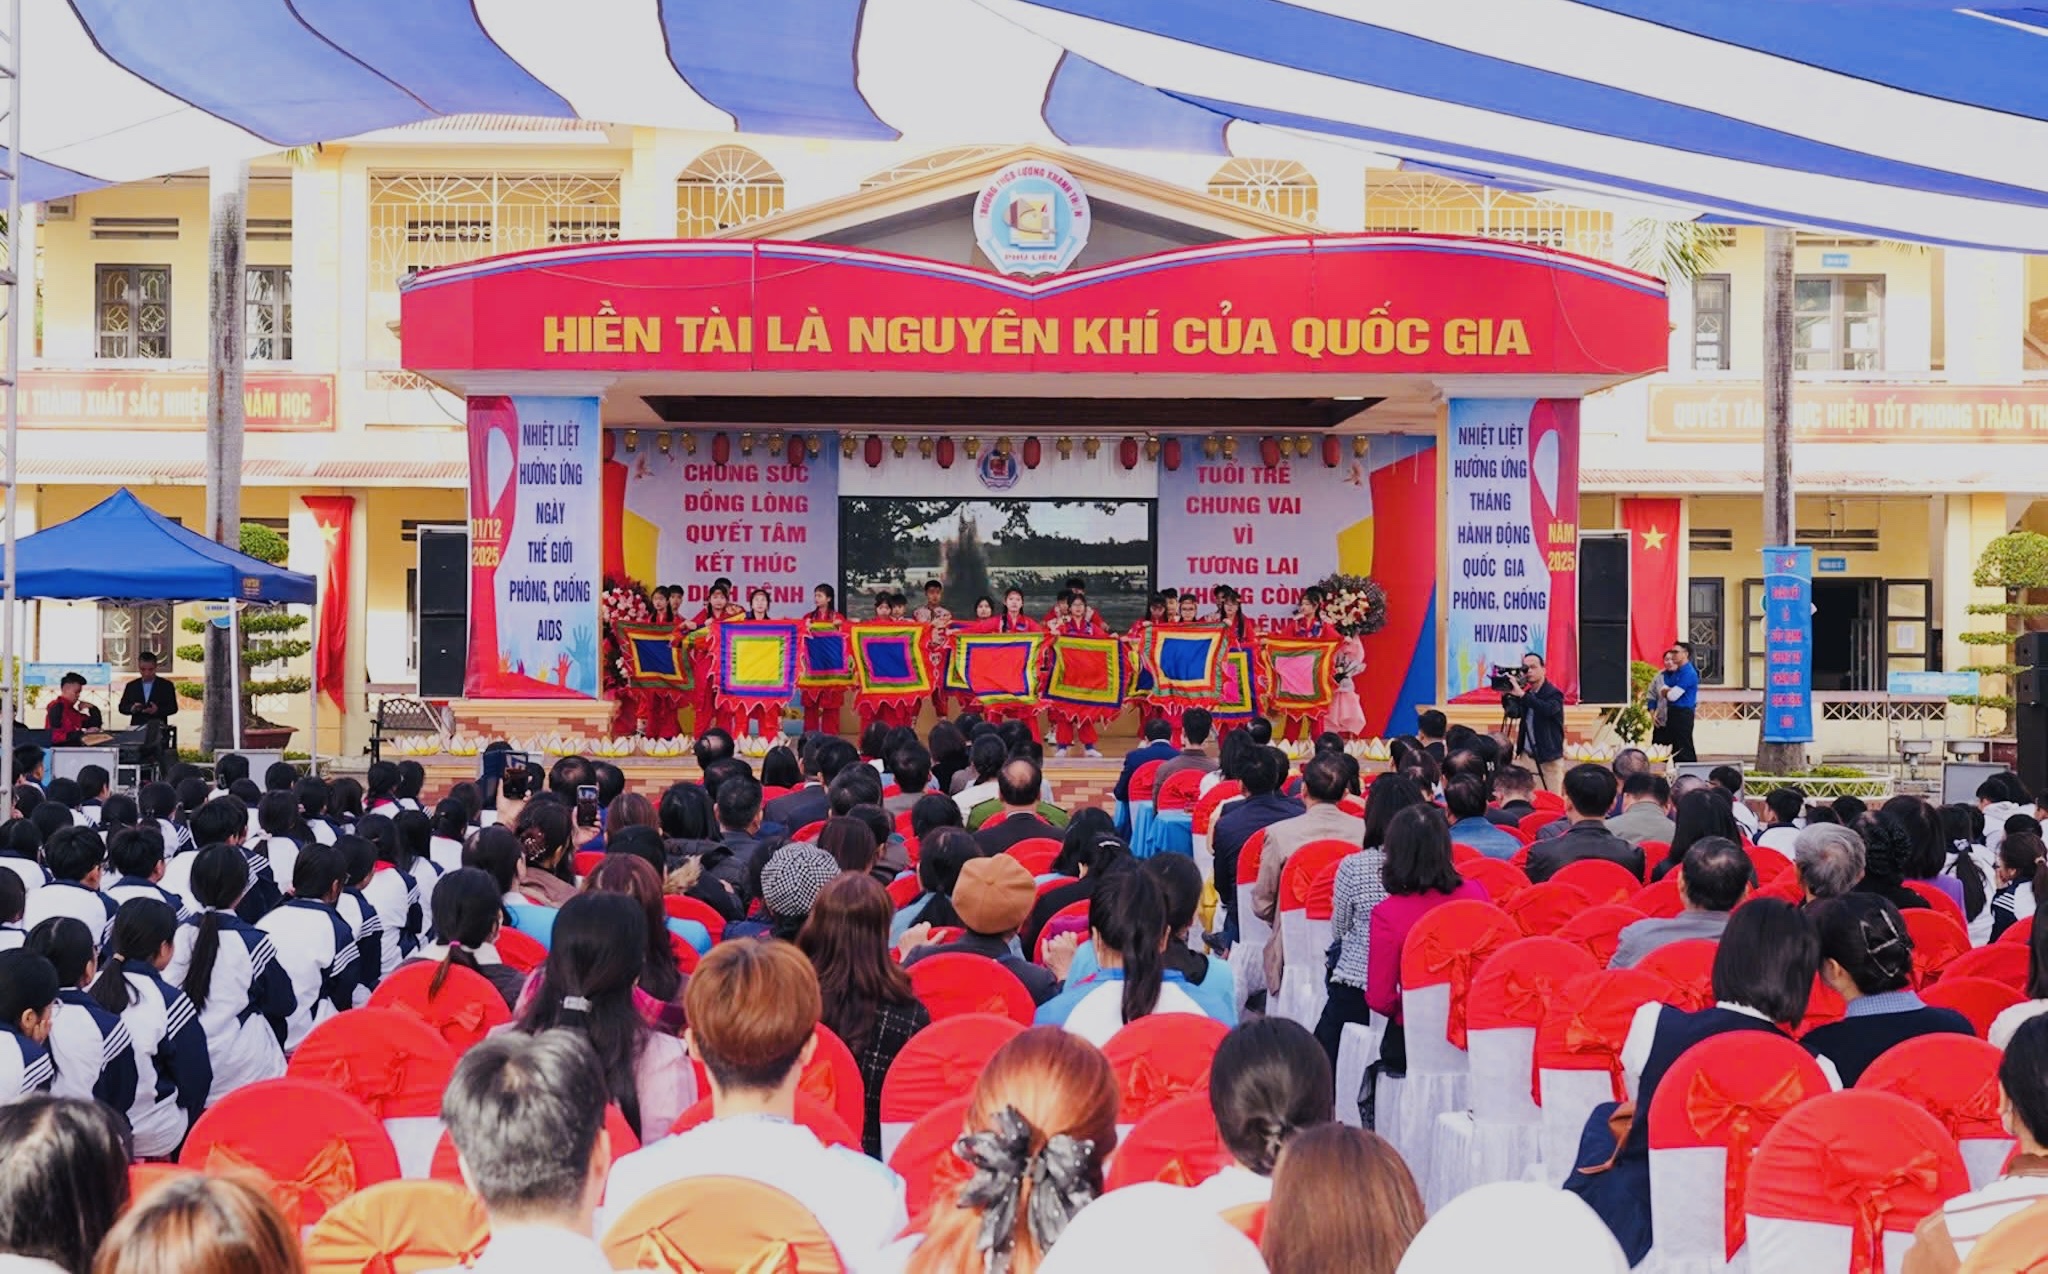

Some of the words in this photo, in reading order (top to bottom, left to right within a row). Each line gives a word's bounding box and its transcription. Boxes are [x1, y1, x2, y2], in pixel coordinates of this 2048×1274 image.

[543, 301, 660, 353] HIỀN
[676, 306, 751, 353] TÀI
[767, 307, 832, 353] LÀ
[849, 308, 1059, 354] NGUYÊN
[1073, 309, 1159, 354] KHÍ
[1172, 300, 1278, 355] CỦA
[1291, 301, 1429, 358] QUỐC
[1443, 318, 1531, 355] GIA
[281, 391, 311, 423] HỌC
[1827, 397, 1869, 434] HIỆN
[1874, 394, 1905, 429] TỐT
[1910, 403, 1972, 430] PHONG
[1977, 398, 2025, 430] TRÀO
[523, 420, 554, 451] NHIỆT
[558, 420, 580, 451] LIỆT
[1459, 423, 1494, 450] NHIỆT
[1499, 423, 1524, 450] LIỆT
[519, 457, 556, 485] HƯỞNG
[560, 459, 582, 485] ỨNG
[684, 464, 758, 482] CHUNG
[1197, 459, 1244, 484] TUỔI
[1251, 461, 1290, 484] TRẺ
[1454, 454, 1497, 478] HƯỞNG
[1501, 456, 1527, 478] ỨNG
[536, 498, 565, 524] NGÀY
[684, 489, 745, 512] ĐỒNG
[752, 492, 808, 512] LÒNG
[1186, 497, 1260, 514] CHUNG
[1268, 497, 1301, 514] VAI
[1470, 488, 1511, 511] THÁNG
[686, 518, 753, 544] QUYẾT
[760, 522, 806, 543] TÂM
[1233, 524, 1253, 544] VÌ
[1458, 522, 1492, 544] HÀNH
[1496, 523, 1530, 548] ĐỘNG
[1549, 520, 1574, 543] NĂM
[472, 546, 499, 567] 2025
[528, 533, 548, 563] THẾ
[551, 537, 573, 563] GIỚI
[695, 549, 735, 573] KẾT
[742, 552, 797, 573] THÚC
[1187, 556, 1258, 574] TƯƠNG
[1266, 557, 1298, 574] LAI
[1463, 552, 1496, 579] QUỐC
[1504, 558, 1525, 577] GIA
[1548, 551, 1575, 572] 2025
[509, 575, 550, 605] PHÒNG,
[553, 572, 590, 602] CHỐNG
[688, 585, 738, 605] DỊH
[746, 582, 804, 603] BNH
[1179, 583, 1254, 604] KHG
[1261, 583, 1306, 604] CÒN
[1453, 586, 1499, 611] PHÒNG,
[1503, 585, 1546, 610] CHỐNG
[536, 620, 562, 641] AIDS
[1474, 624, 1527, 643] HIV/AIDS
